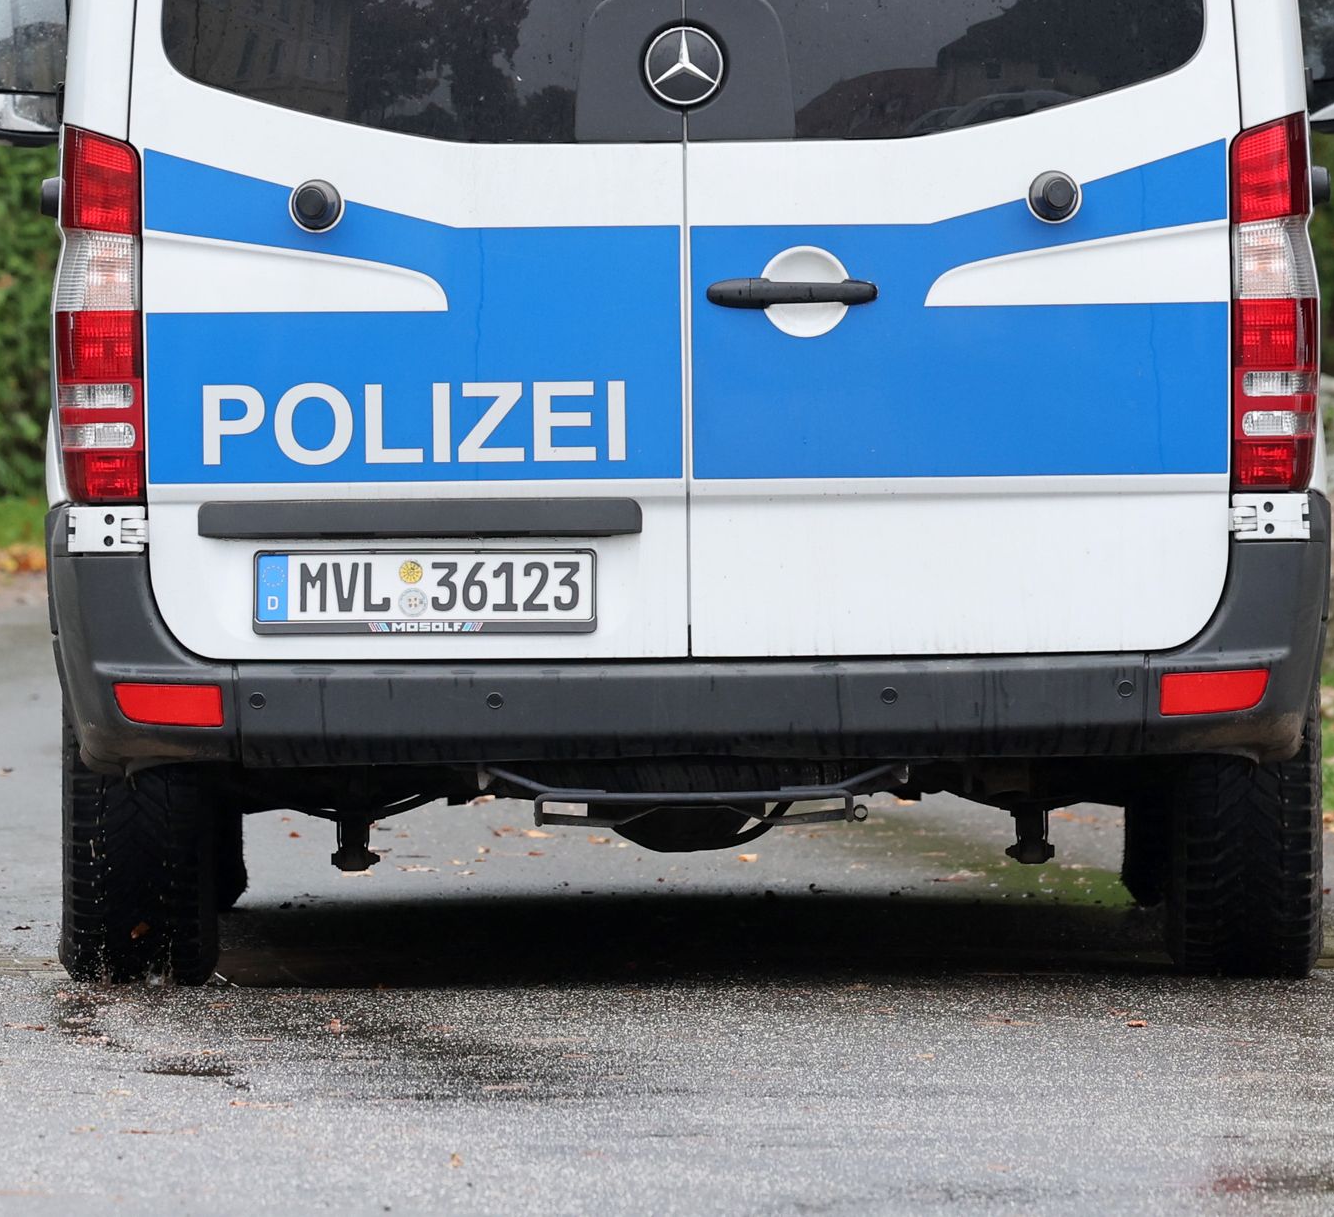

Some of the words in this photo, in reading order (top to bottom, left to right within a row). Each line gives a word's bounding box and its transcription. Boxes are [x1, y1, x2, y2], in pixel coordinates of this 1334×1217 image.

[201, 380, 627, 466] POLIZEI
[267, 595, 279, 611] D
[299, 561, 391, 613] MVL
[430, 560, 581, 612] 36123
[391, 622, 463, 633] MOSOLF
